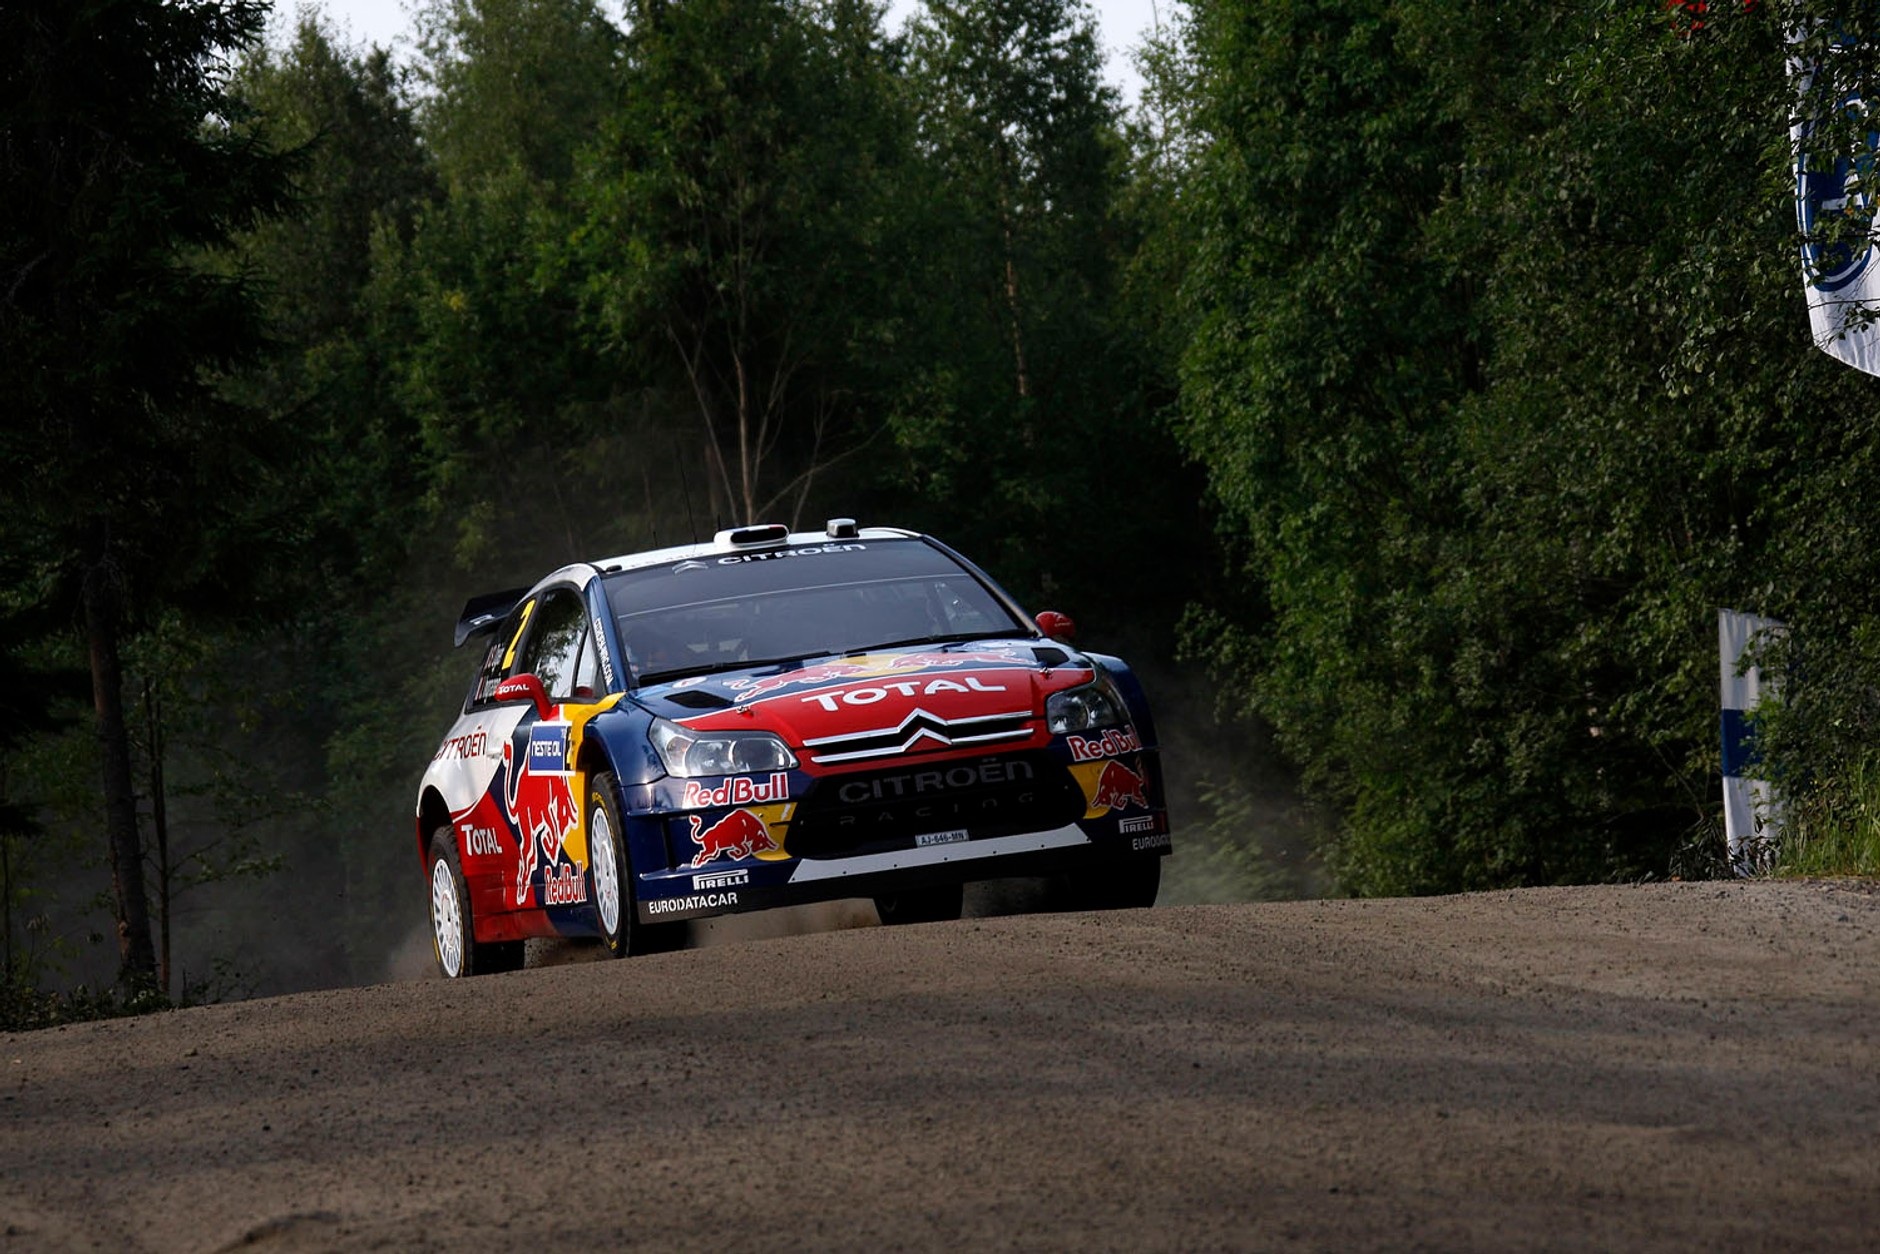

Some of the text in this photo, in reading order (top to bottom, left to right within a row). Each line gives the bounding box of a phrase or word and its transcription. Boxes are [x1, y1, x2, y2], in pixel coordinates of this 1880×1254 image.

[502, 600, 536, 670] 1
[499, 684, 530, 695] TOTAL
[801, 677, 1007, 712] TOTAL
[1066, 730, 1118, 761] Red
[682, 772, 789, 809] Red Bull
[461, 824, 503, 856] TOTAL
[1119, 815, 1154, 834] PIRELLI
[545, 860, 587, 905] Red Bull
[692, 869, 749, 890] PIRELLI
[648, 892, 738, 914] EURODATACAR
